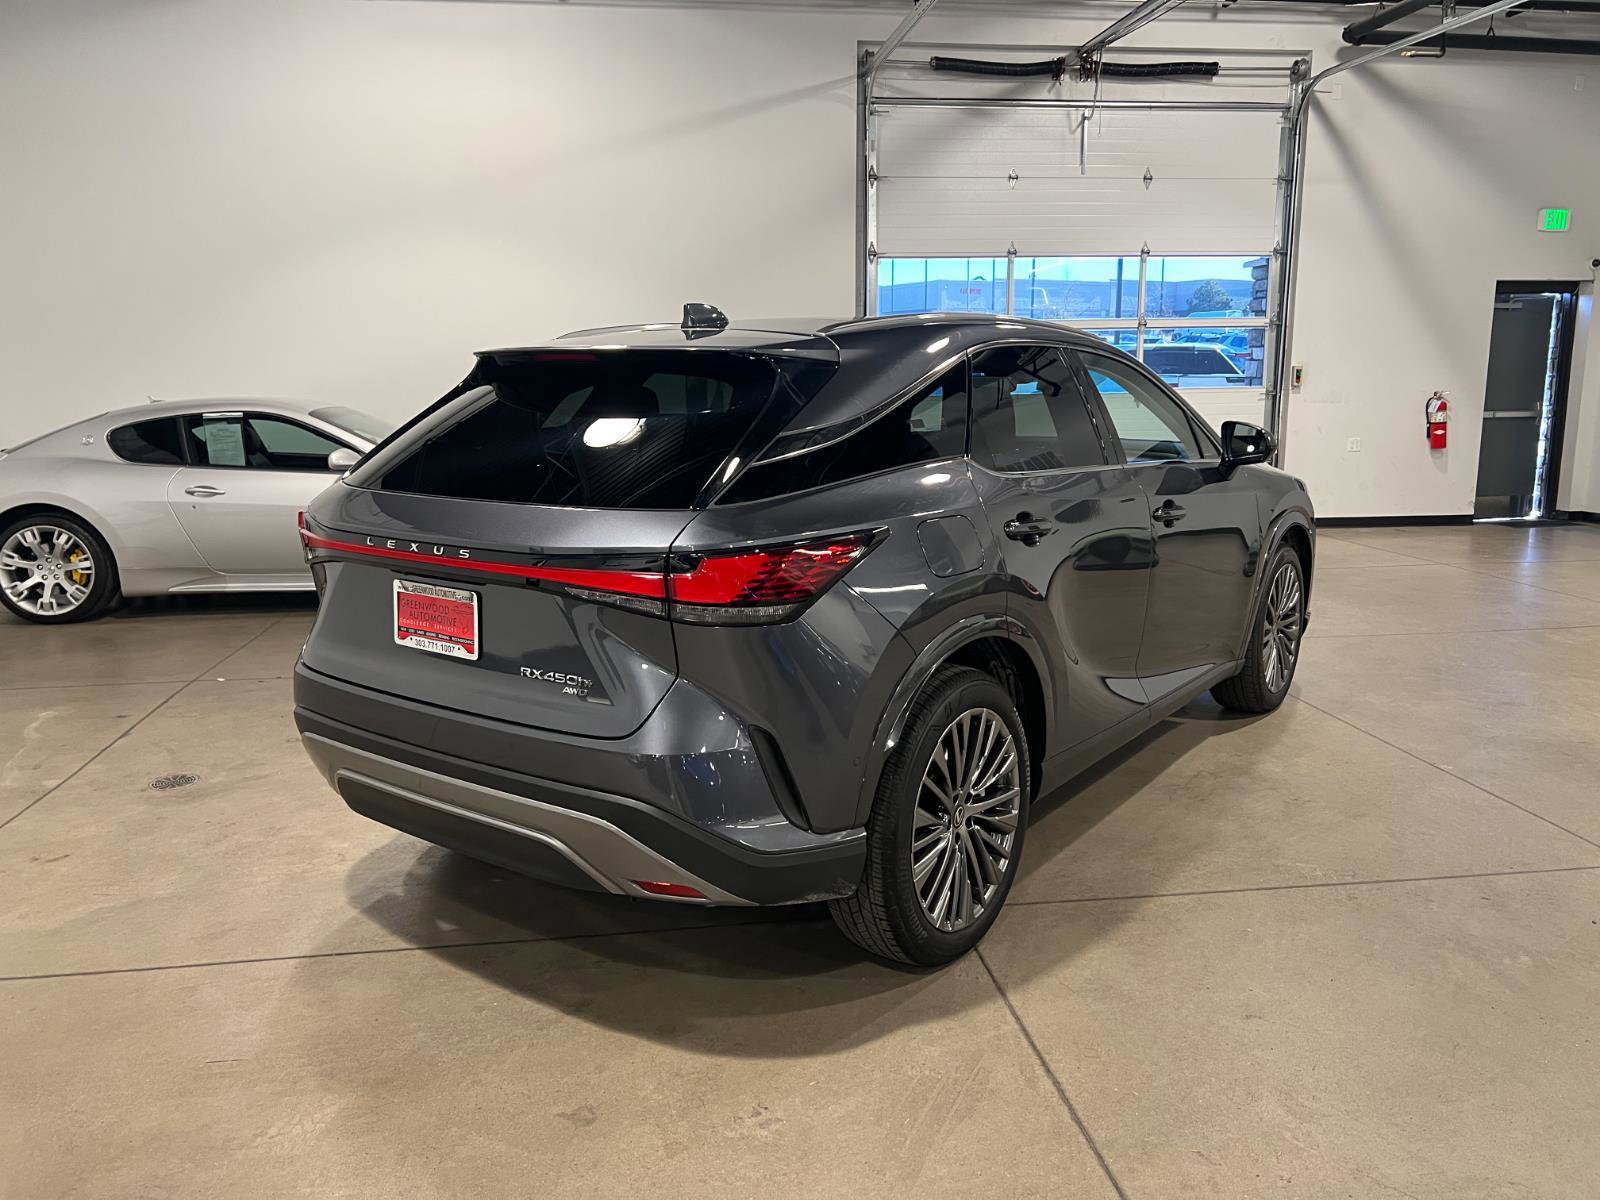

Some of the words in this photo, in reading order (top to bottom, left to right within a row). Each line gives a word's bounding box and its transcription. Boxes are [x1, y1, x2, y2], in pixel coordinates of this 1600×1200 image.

[1543, 208, 1568, 230] EXIT
[366, 536, 470, 558] LEXUS
[400, 597, 450, 615] GREENWOOD
[409, 610, 457, 627] AUTOMOTIVE
[414, 637, 456, 654] 303.771.1007
[562, 686, 588, 697] AWD
